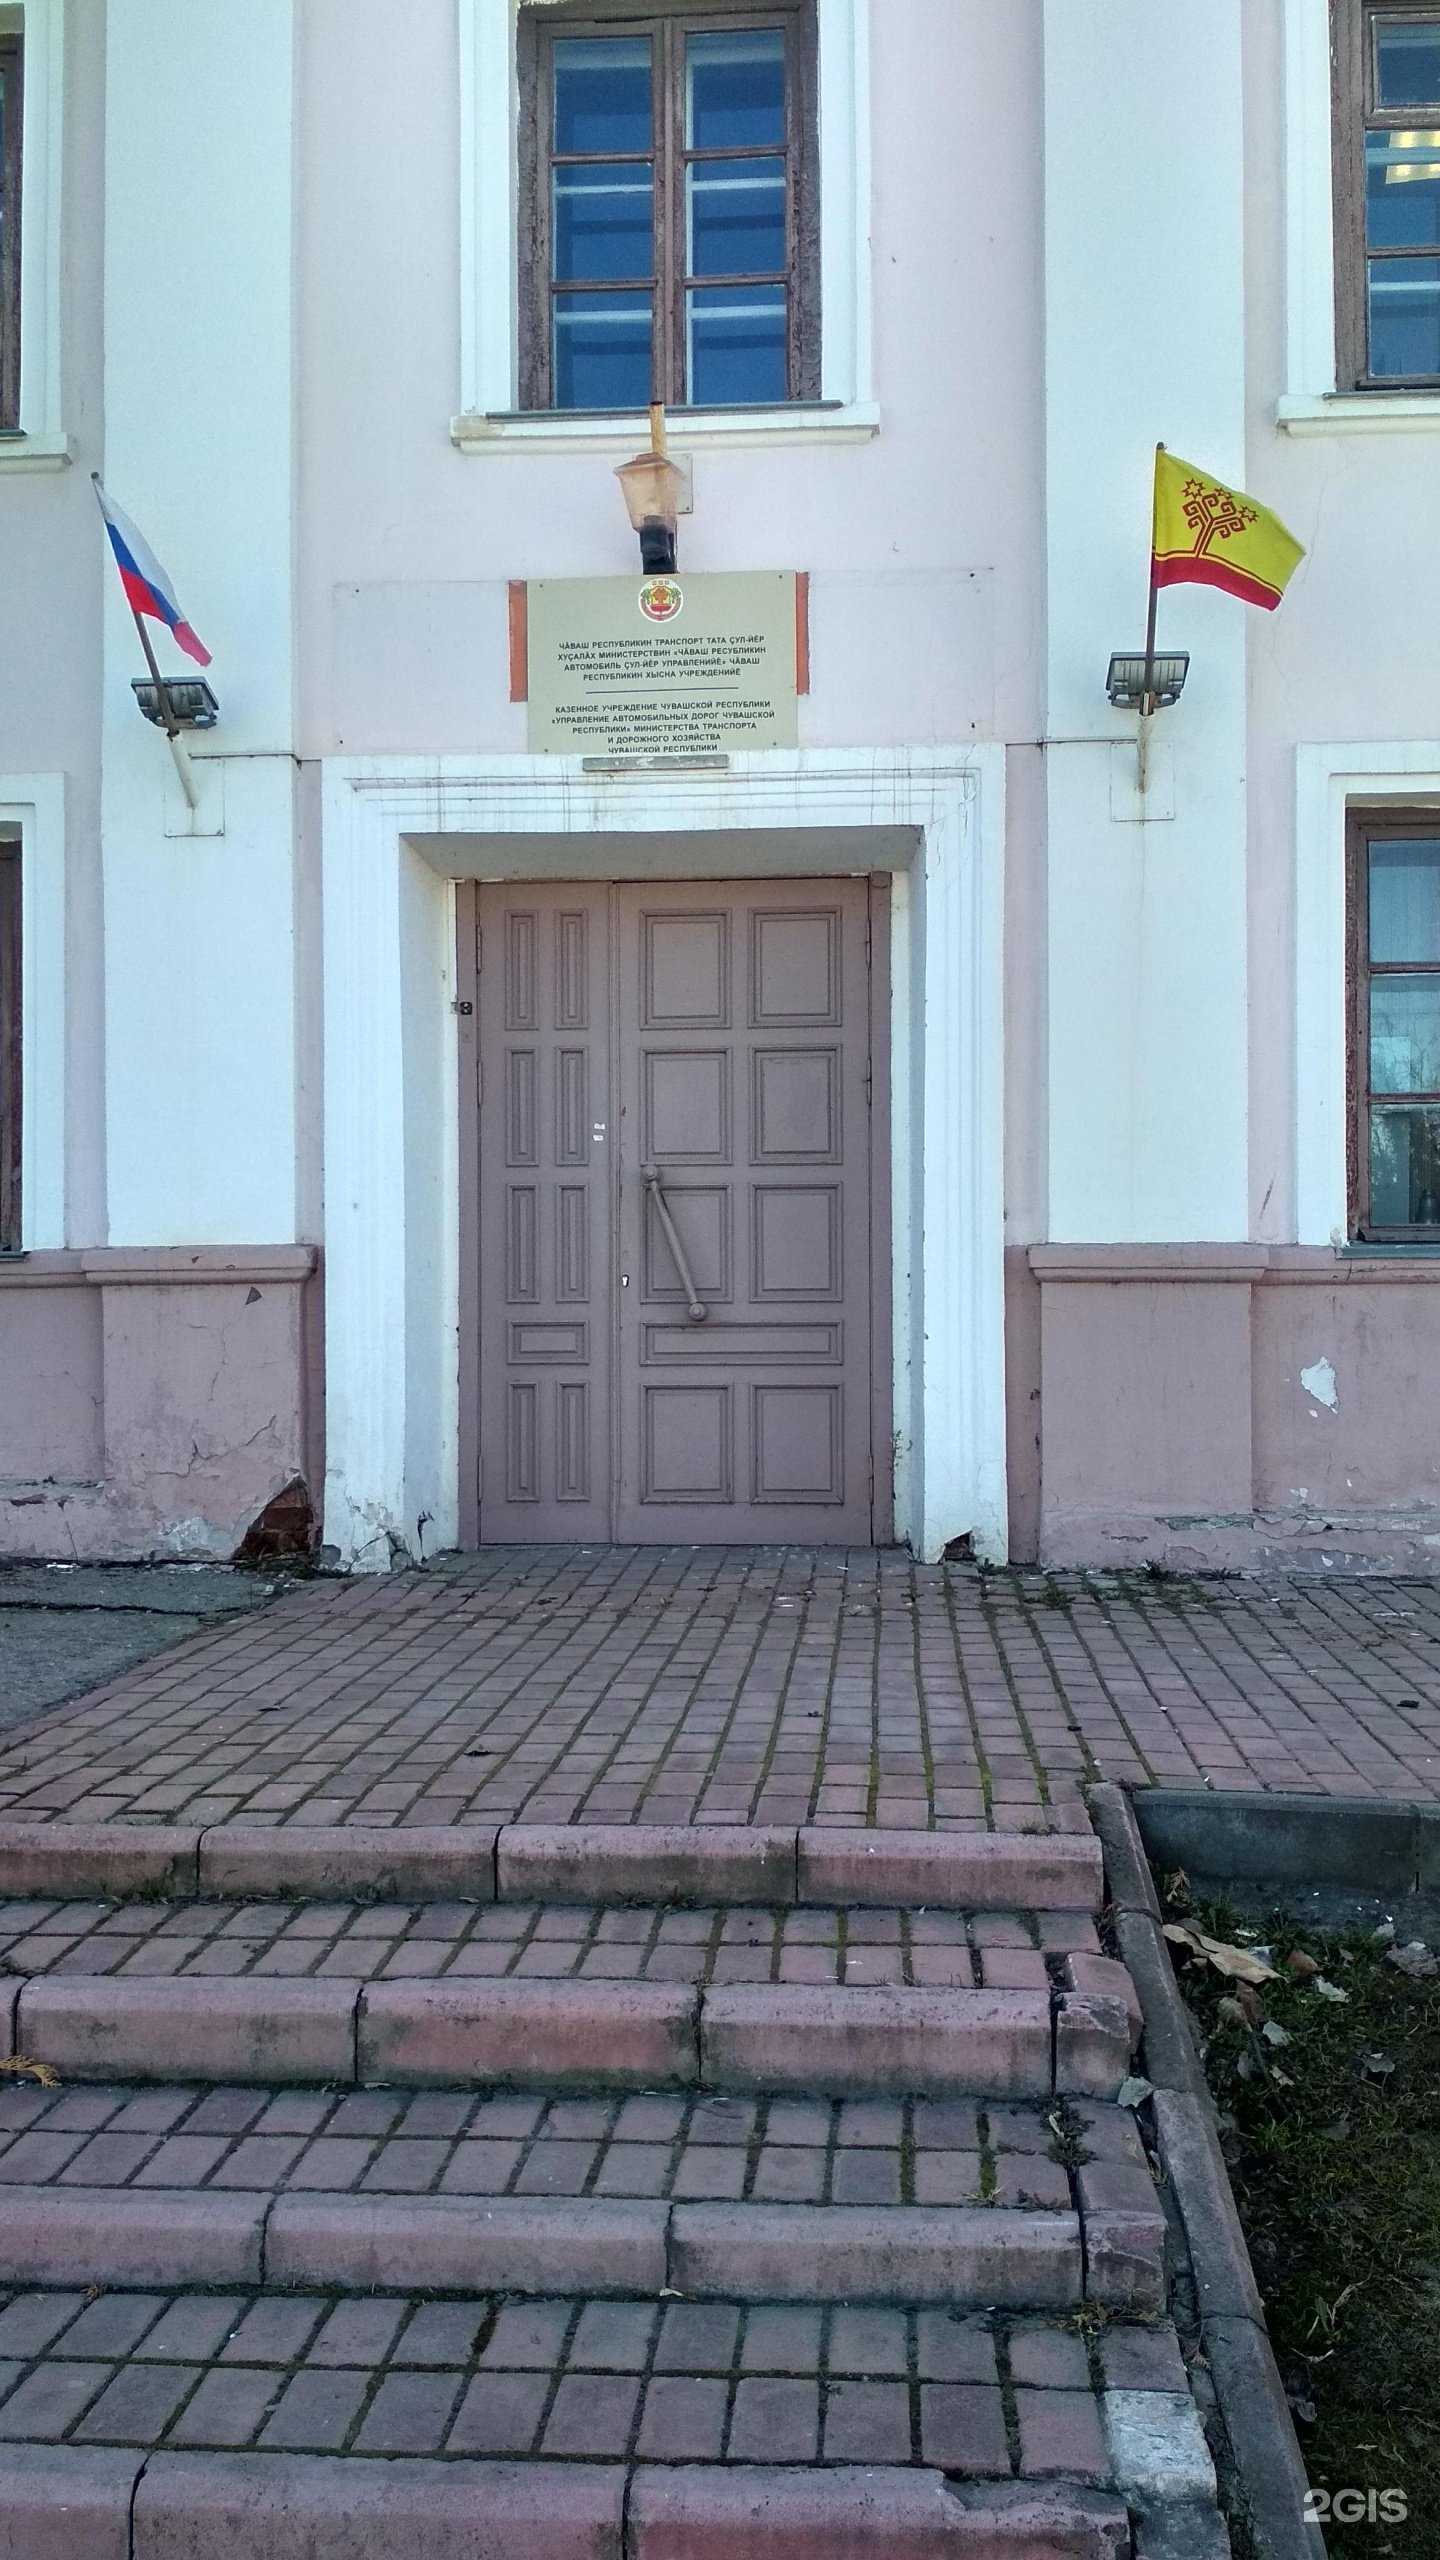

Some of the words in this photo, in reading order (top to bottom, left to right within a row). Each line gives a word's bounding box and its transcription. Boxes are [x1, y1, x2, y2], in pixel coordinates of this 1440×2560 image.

[592, 639, 652, 648] РЕСПУБЛИКИН
[655, 637, 703, 646] ТРАНСПОРТ
[706, 637, 727, 645] ТАТА
[599, 649, 670, 659] МИНИСТЕРСТВИН
[711, 646, 766, 655] РЕСУБЛИКИН
[564, 662, 621, 671] АВТОМОБИЛЬ
[583, 671, 643, 681] РЕСПУБЛИКИН
[645, 671, 676, 679] ХЫСНА
[555, 705, 599, 714] КАЗЕННОЕ
[601, 703, 658, 712] УЧРЕЖДЕНИЕ
[660, 700, 713, 710] ЧУВАШСКОЙ
[715, 700, 771, 709] РЕСПУБЛИКИ
[612, 713, 689, 722] АВТОМОБИЛЬНЫХ
[691, 712, 719, 721] ДОРОГ
[722, 710, 775, 719] ЧУВАШСКОЙ
[633, 723, 699, 733] МИНИСТЕРСТВА
[702, 722, 757, 731] ТРАНСПОРТА
[616, 735, 670, 745] ДОРОЖНОГО
[672, 733, 721, 742] ХОЗЯЙСТВА
[608, 745, 660, 754] ЧУВАШСКОЙ
[663, 744, 718, 753] РЕСПУБЛИКИ
